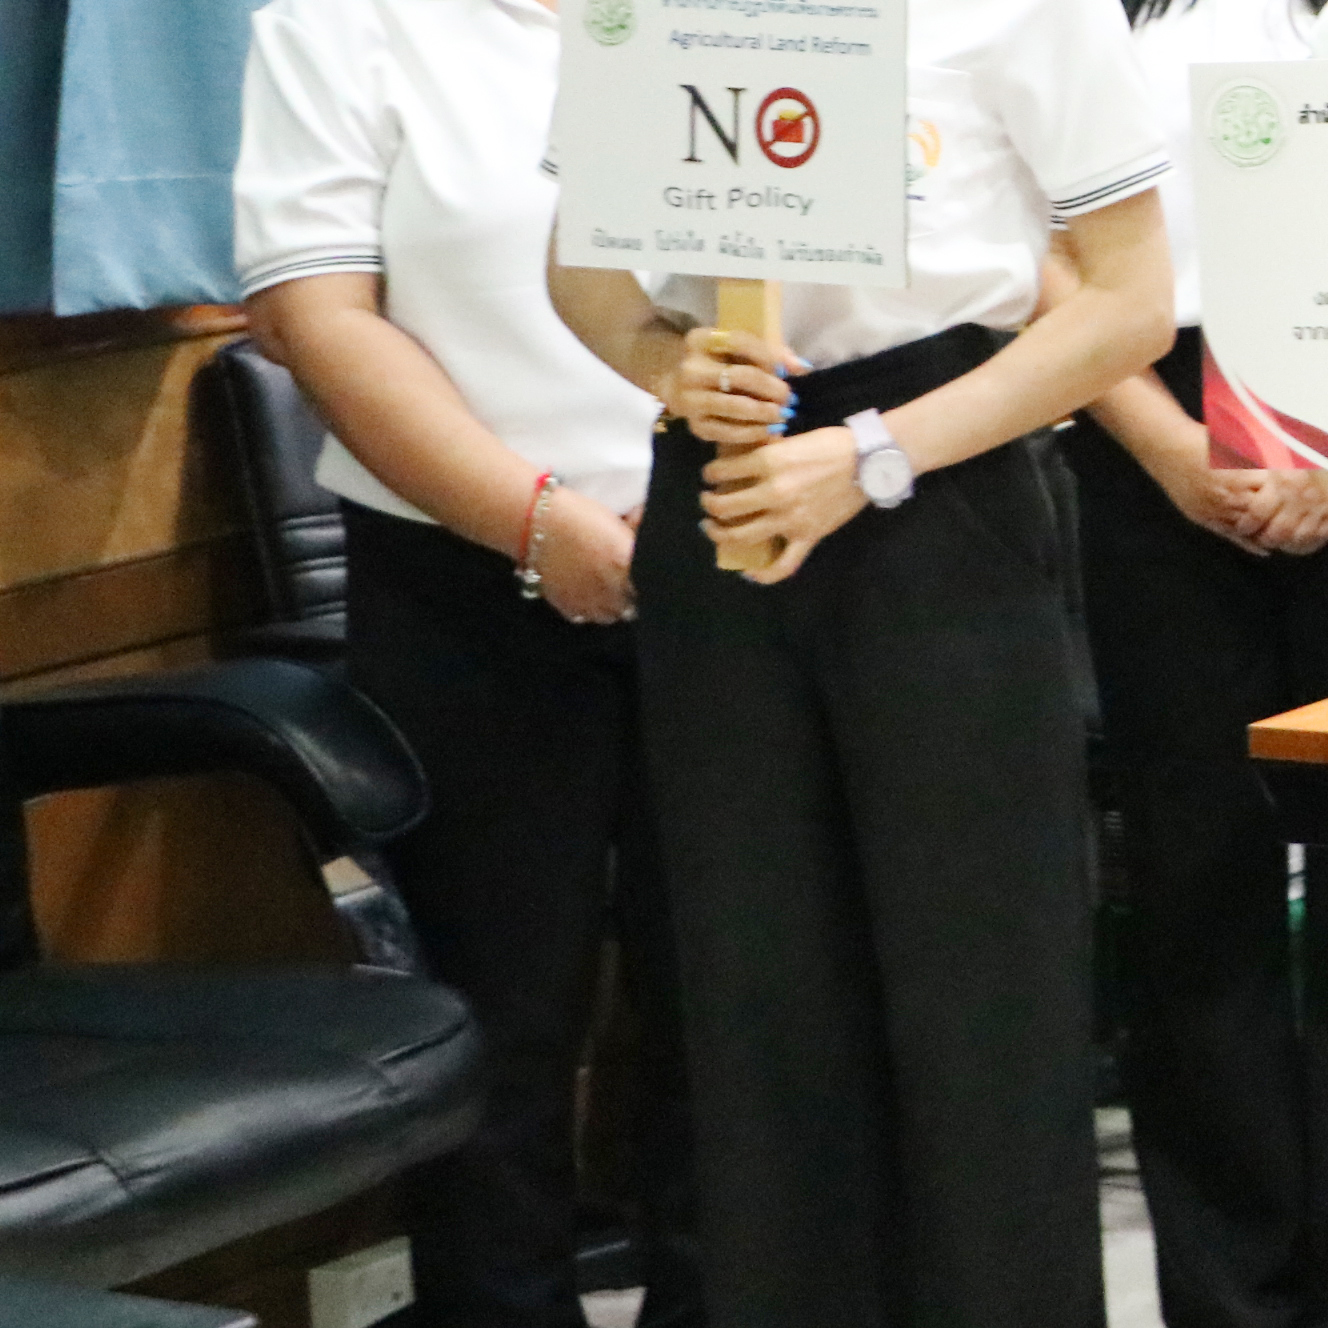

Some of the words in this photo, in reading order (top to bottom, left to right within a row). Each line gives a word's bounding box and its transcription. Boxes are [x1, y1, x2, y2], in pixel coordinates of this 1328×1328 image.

[768, 33, 807, 52] Land
[811, 35, 872, 55] Reform
[663, 186, 717, 211] Gift
[727, 187, 815, 215] Policy
